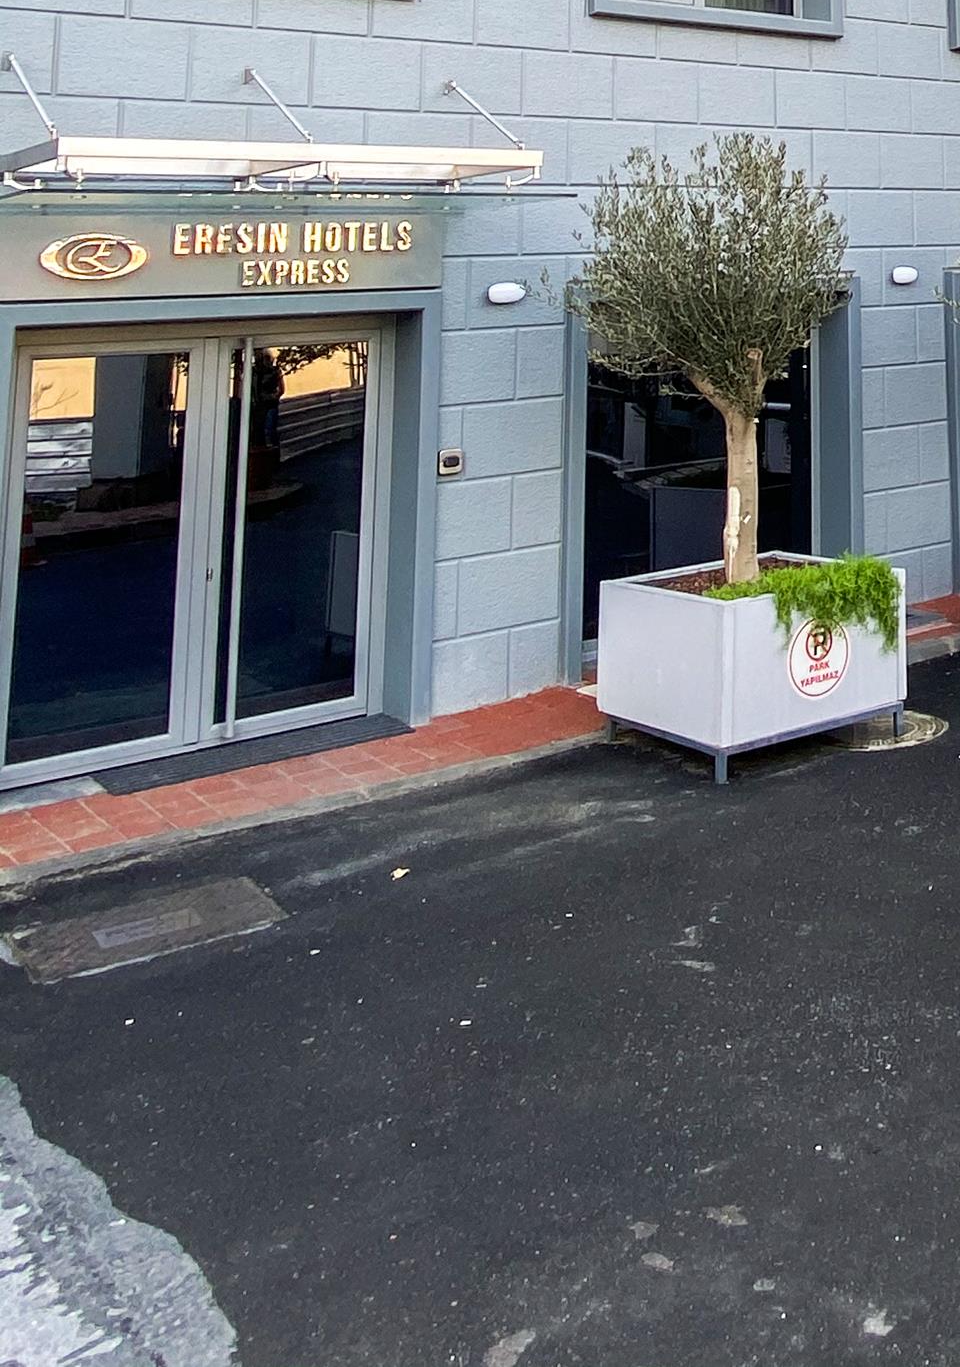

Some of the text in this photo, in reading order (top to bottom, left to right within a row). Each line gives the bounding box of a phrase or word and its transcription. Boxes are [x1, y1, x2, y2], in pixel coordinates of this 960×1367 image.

[173, 220, 413, 255] ERESIN HOTELS
[242, 258, 350, 286] EXPRESS
[808, 660, 830, 673] PARK
[800, 670, 839, 687] YAPILMAZ
